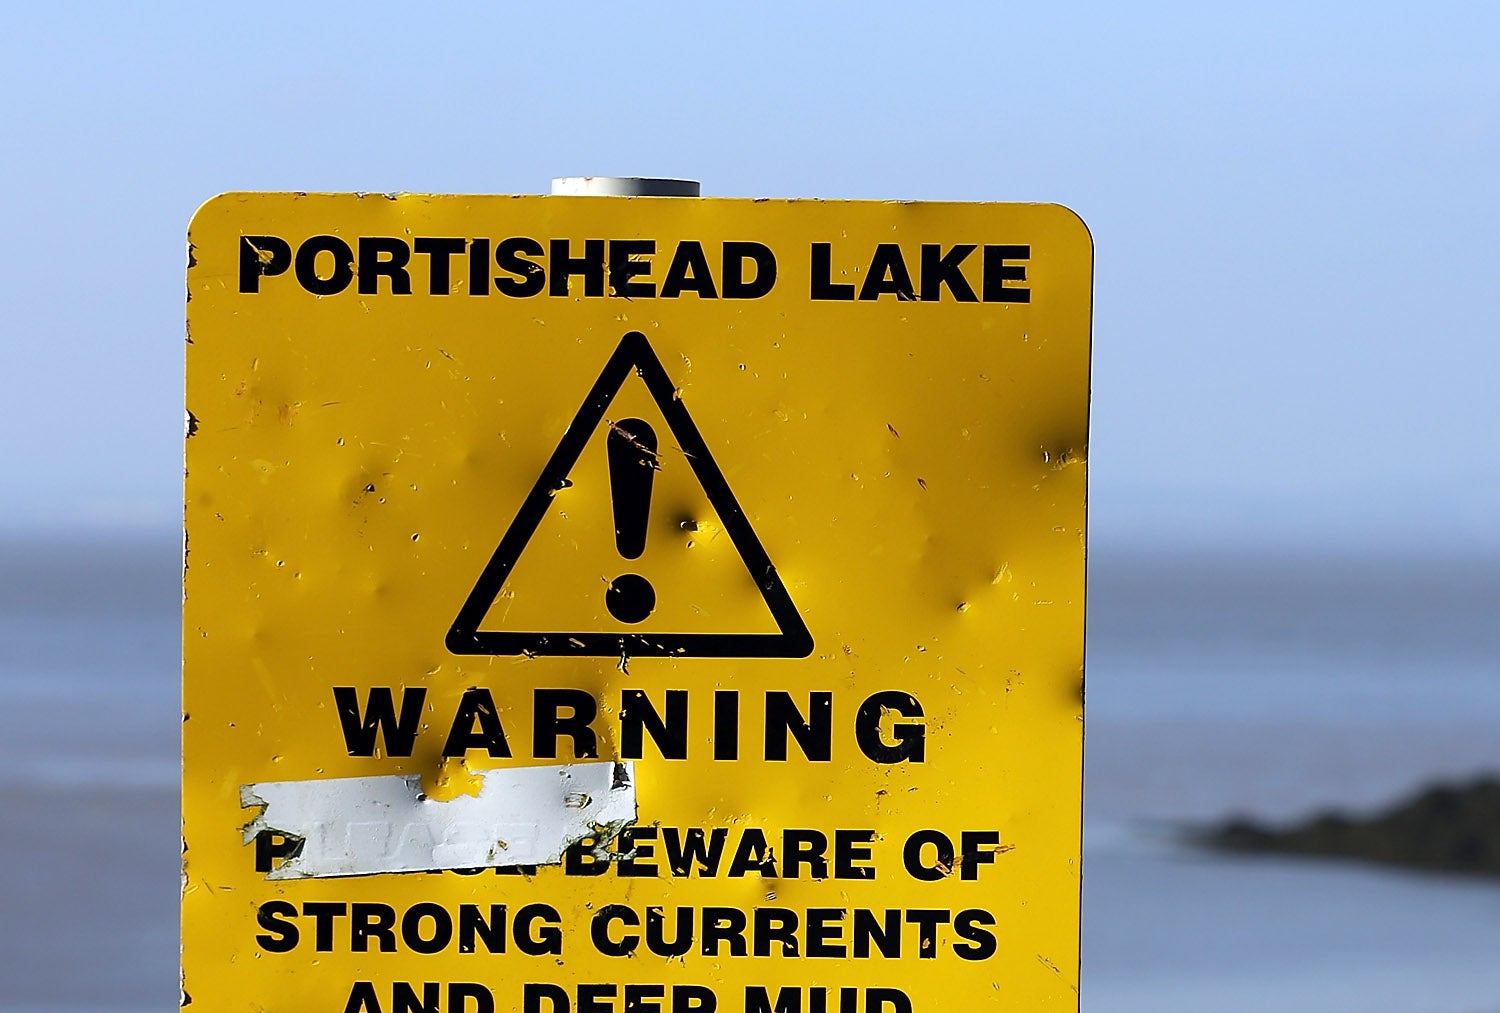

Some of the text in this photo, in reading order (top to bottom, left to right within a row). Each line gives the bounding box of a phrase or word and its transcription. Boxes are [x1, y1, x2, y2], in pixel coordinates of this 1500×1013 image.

[239, 235, 1031, 304] PORTISHEAD LAKE
[332, 686, 926, 765] WARNING
[903, 829, 1000, 882] OF
[255, 900, 997, 961] STRONG CURRENTS
